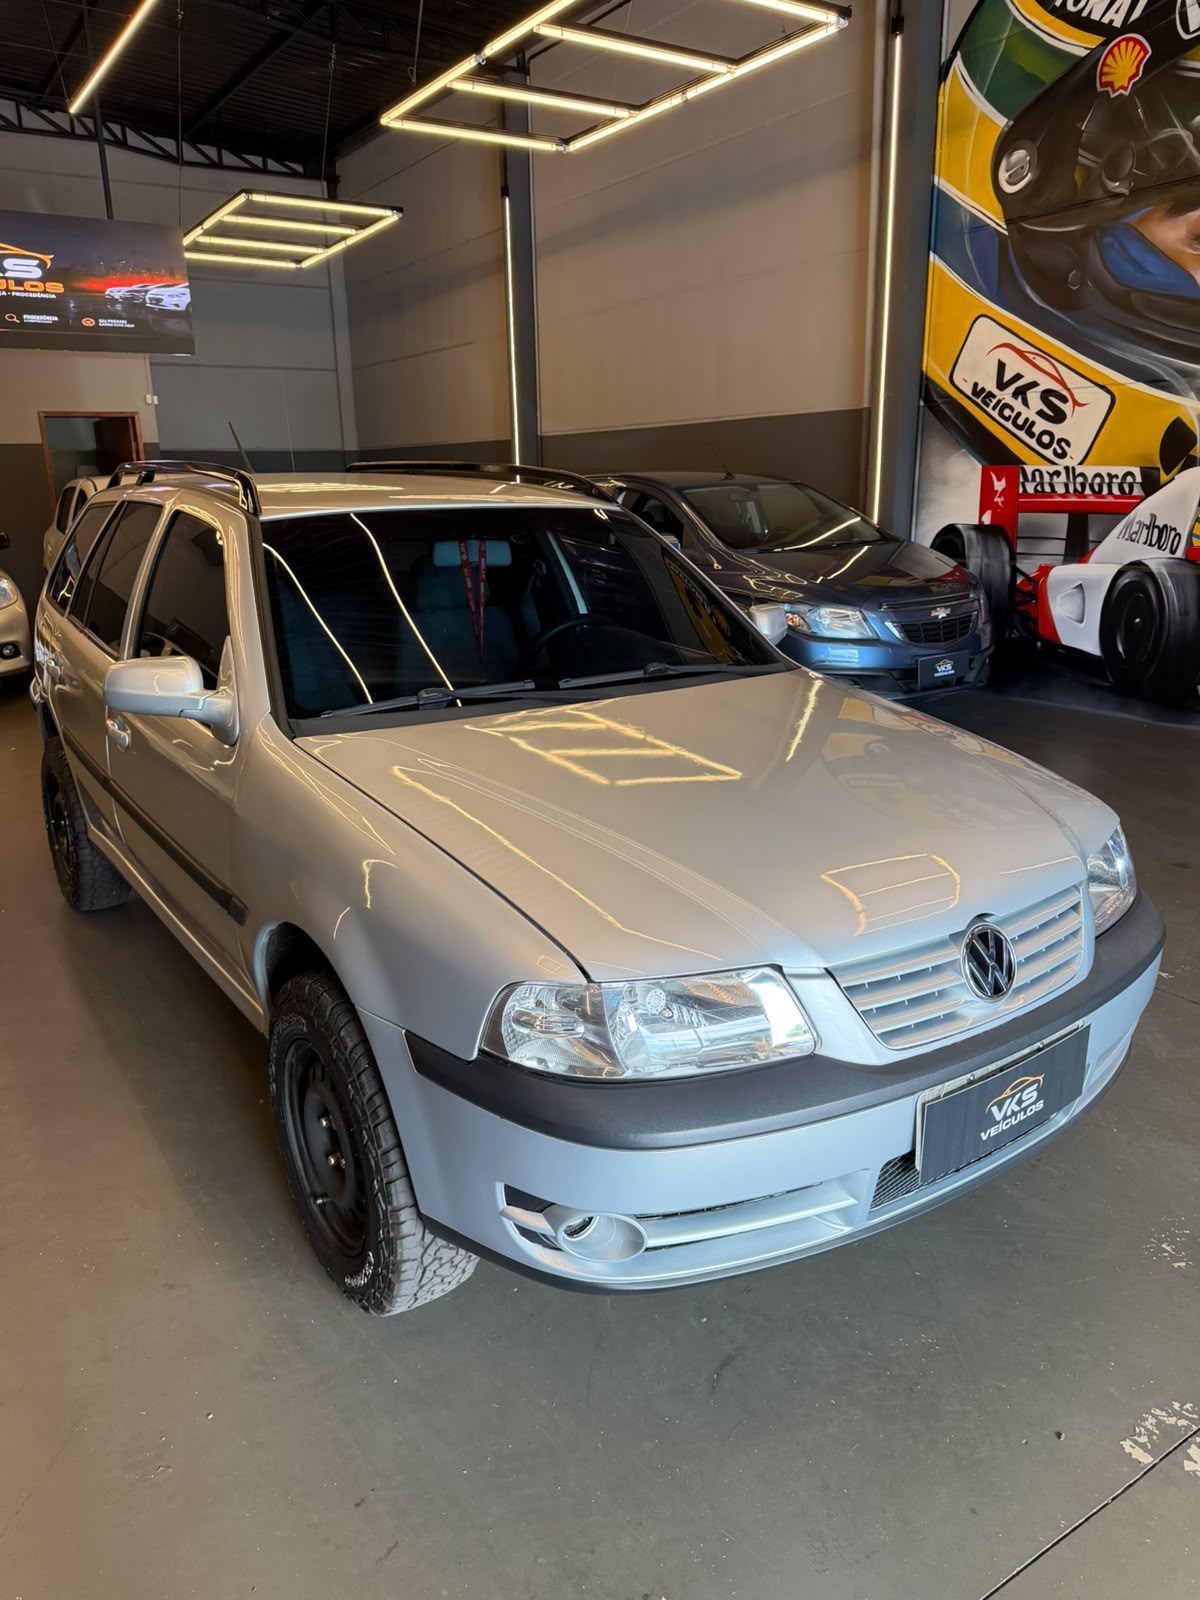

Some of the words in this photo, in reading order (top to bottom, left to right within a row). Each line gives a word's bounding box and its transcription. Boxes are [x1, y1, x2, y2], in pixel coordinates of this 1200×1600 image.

[0, 258, 42, 279] S
[995, 358, 1070, 425] VKS
[1116, 512, 1182, 556] Marlboro
[980, 1099, 1045, 1141] VEÍCULOS
[990, 1082, 1039, 1122] VKS
